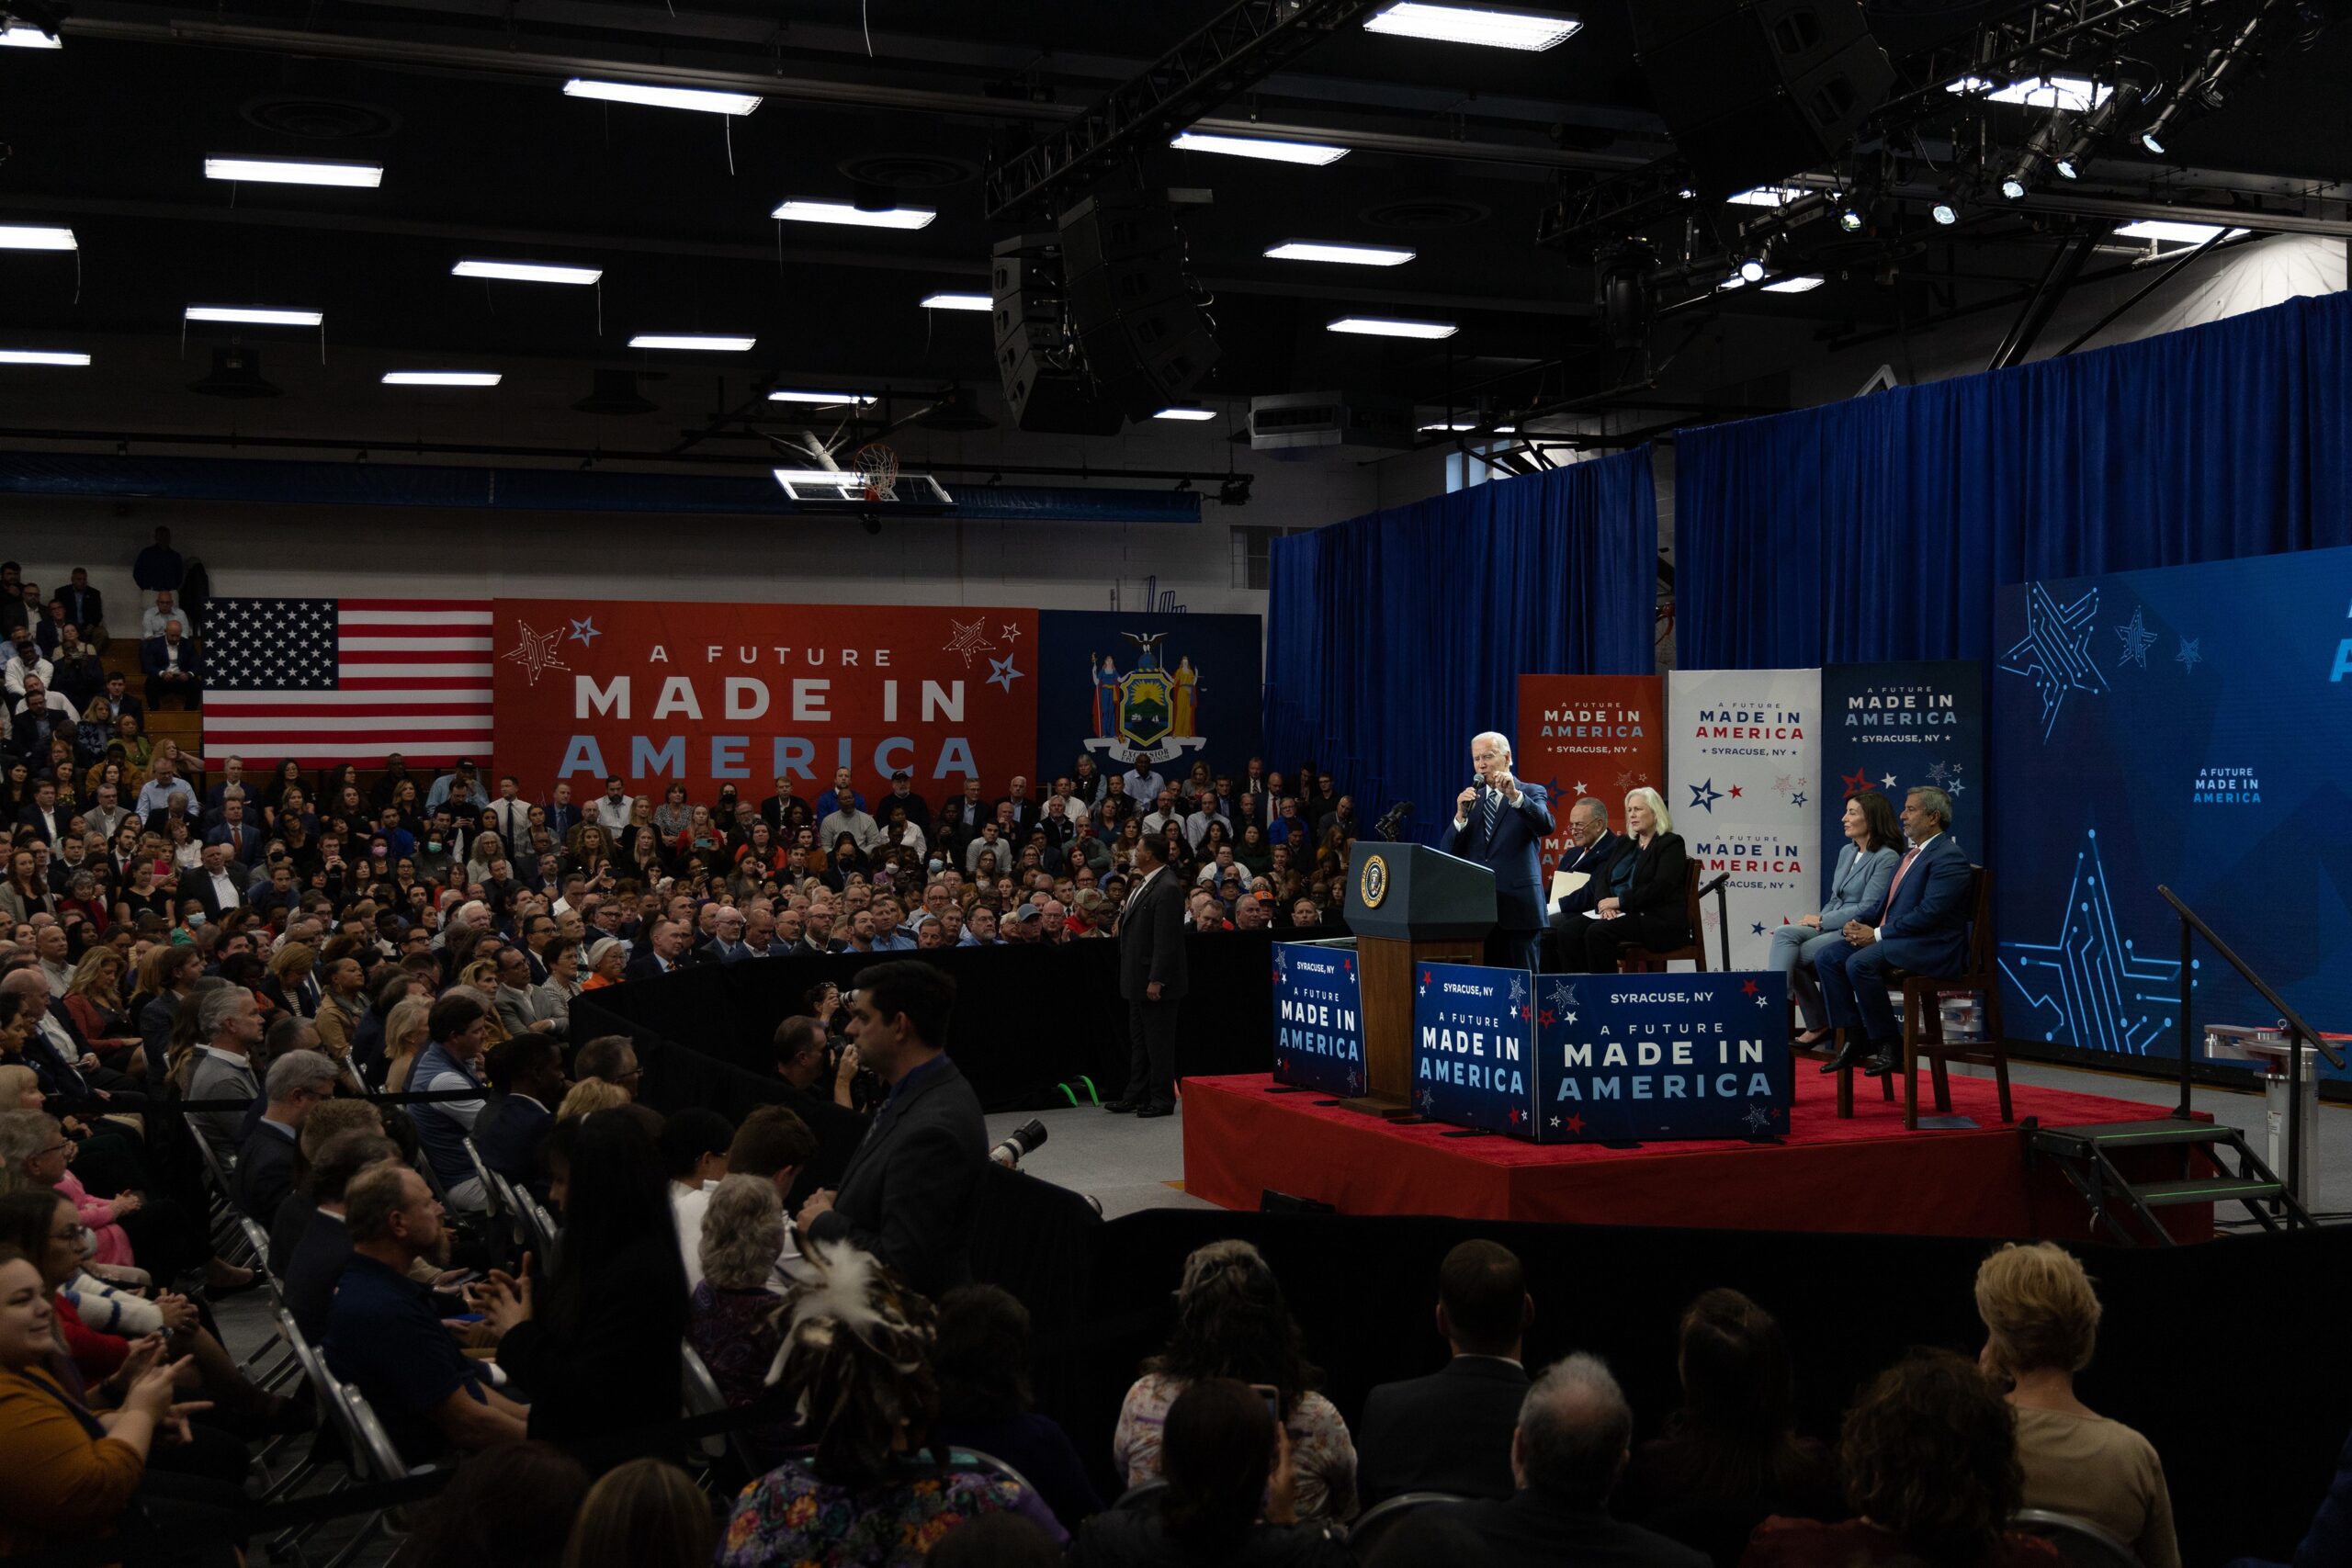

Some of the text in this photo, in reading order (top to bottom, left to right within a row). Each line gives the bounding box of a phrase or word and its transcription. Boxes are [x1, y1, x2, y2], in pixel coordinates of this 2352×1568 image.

[650, 645, 891, 667] A FUTURE
[574, 676, 965, 723] MADE IN
[1849, 694, 1953, 709] MADE IN
[1544, 710, 1640, 722] MADE IN
[1700, 711, 1800, 724] MADE IN
[1845, 711, 1957, 726] AMERICA
[1541, 726, 1644, 738] AMERICA
[1696, 727, 1804, 739] AMERICA
[1861, 734, 1939, 743] SYRACUSE, NY
[1556, 746, 1611, 754] SYRACUSE,
[1712, 748, 1769, 756] SYRACUSE,
[557, 735, 979, 780] AMERICA
[2200, 768, 2253, 776] A FUTURE
[2195, 779, 2258, 790] MADE IN
[2193, 793, 2261, 803] AMERICA
[1545, 839, 1576, 850] MA
[1697, 843, 1798, 857] MADE IN
[1711, 881, 1767, 889] RACUSE,
[1296, 961, 1335, 974] SYRACUSE, NY
[1294, 987, 1340, 1002] A FUTURE
[1443, 983, 1494, 997] SYRACUSE, NY
[1611, 991, 1713, 1004] SYRACUSE, NY
[1281, 999, 1355, 1032] MADE IN
[1439, 1011, 1498, 1028] A FUTURE
[1600, 1022, 1724, 1035] A FUTURE
[1279, 1027, 1359, 1061] AMERICA
[1422, 1026, 1519, 1061] MADE IN
[1564, 1039, 1763, 1067] MADE IN
[1419, 1056, 1524, 1095] AMERICA
[1556, 1072, 1772, 1101] AMERICA
